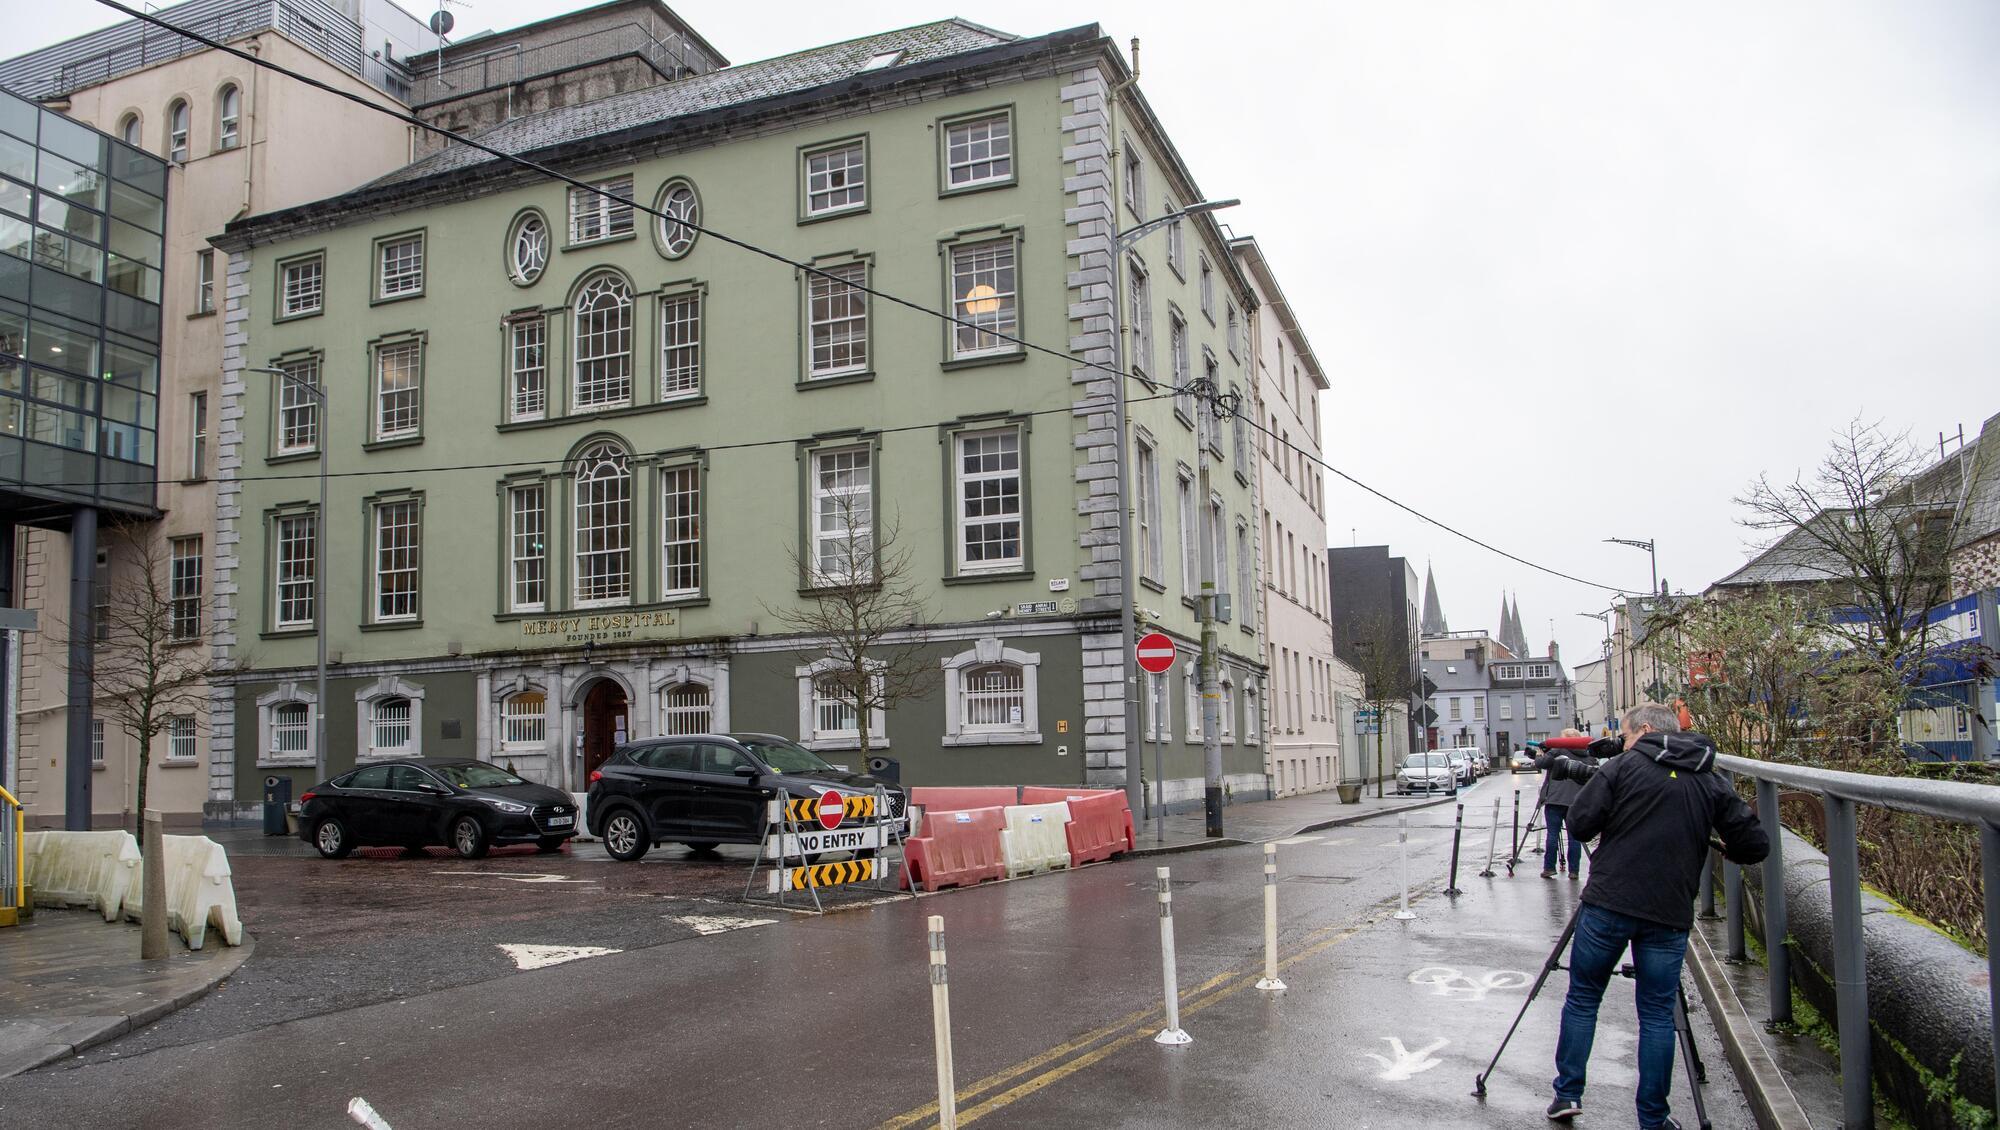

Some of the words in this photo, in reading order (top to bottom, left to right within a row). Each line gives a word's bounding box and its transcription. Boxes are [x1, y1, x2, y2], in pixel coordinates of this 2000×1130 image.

[523, 618, 580, 635] MERCY
[588, 612, 675, 631] HOSPITAL
[566, 632, 608, 641] FOUNDED
[800, 836, 818, 851] NO
[823, 832, 865, 849] ENTRY
